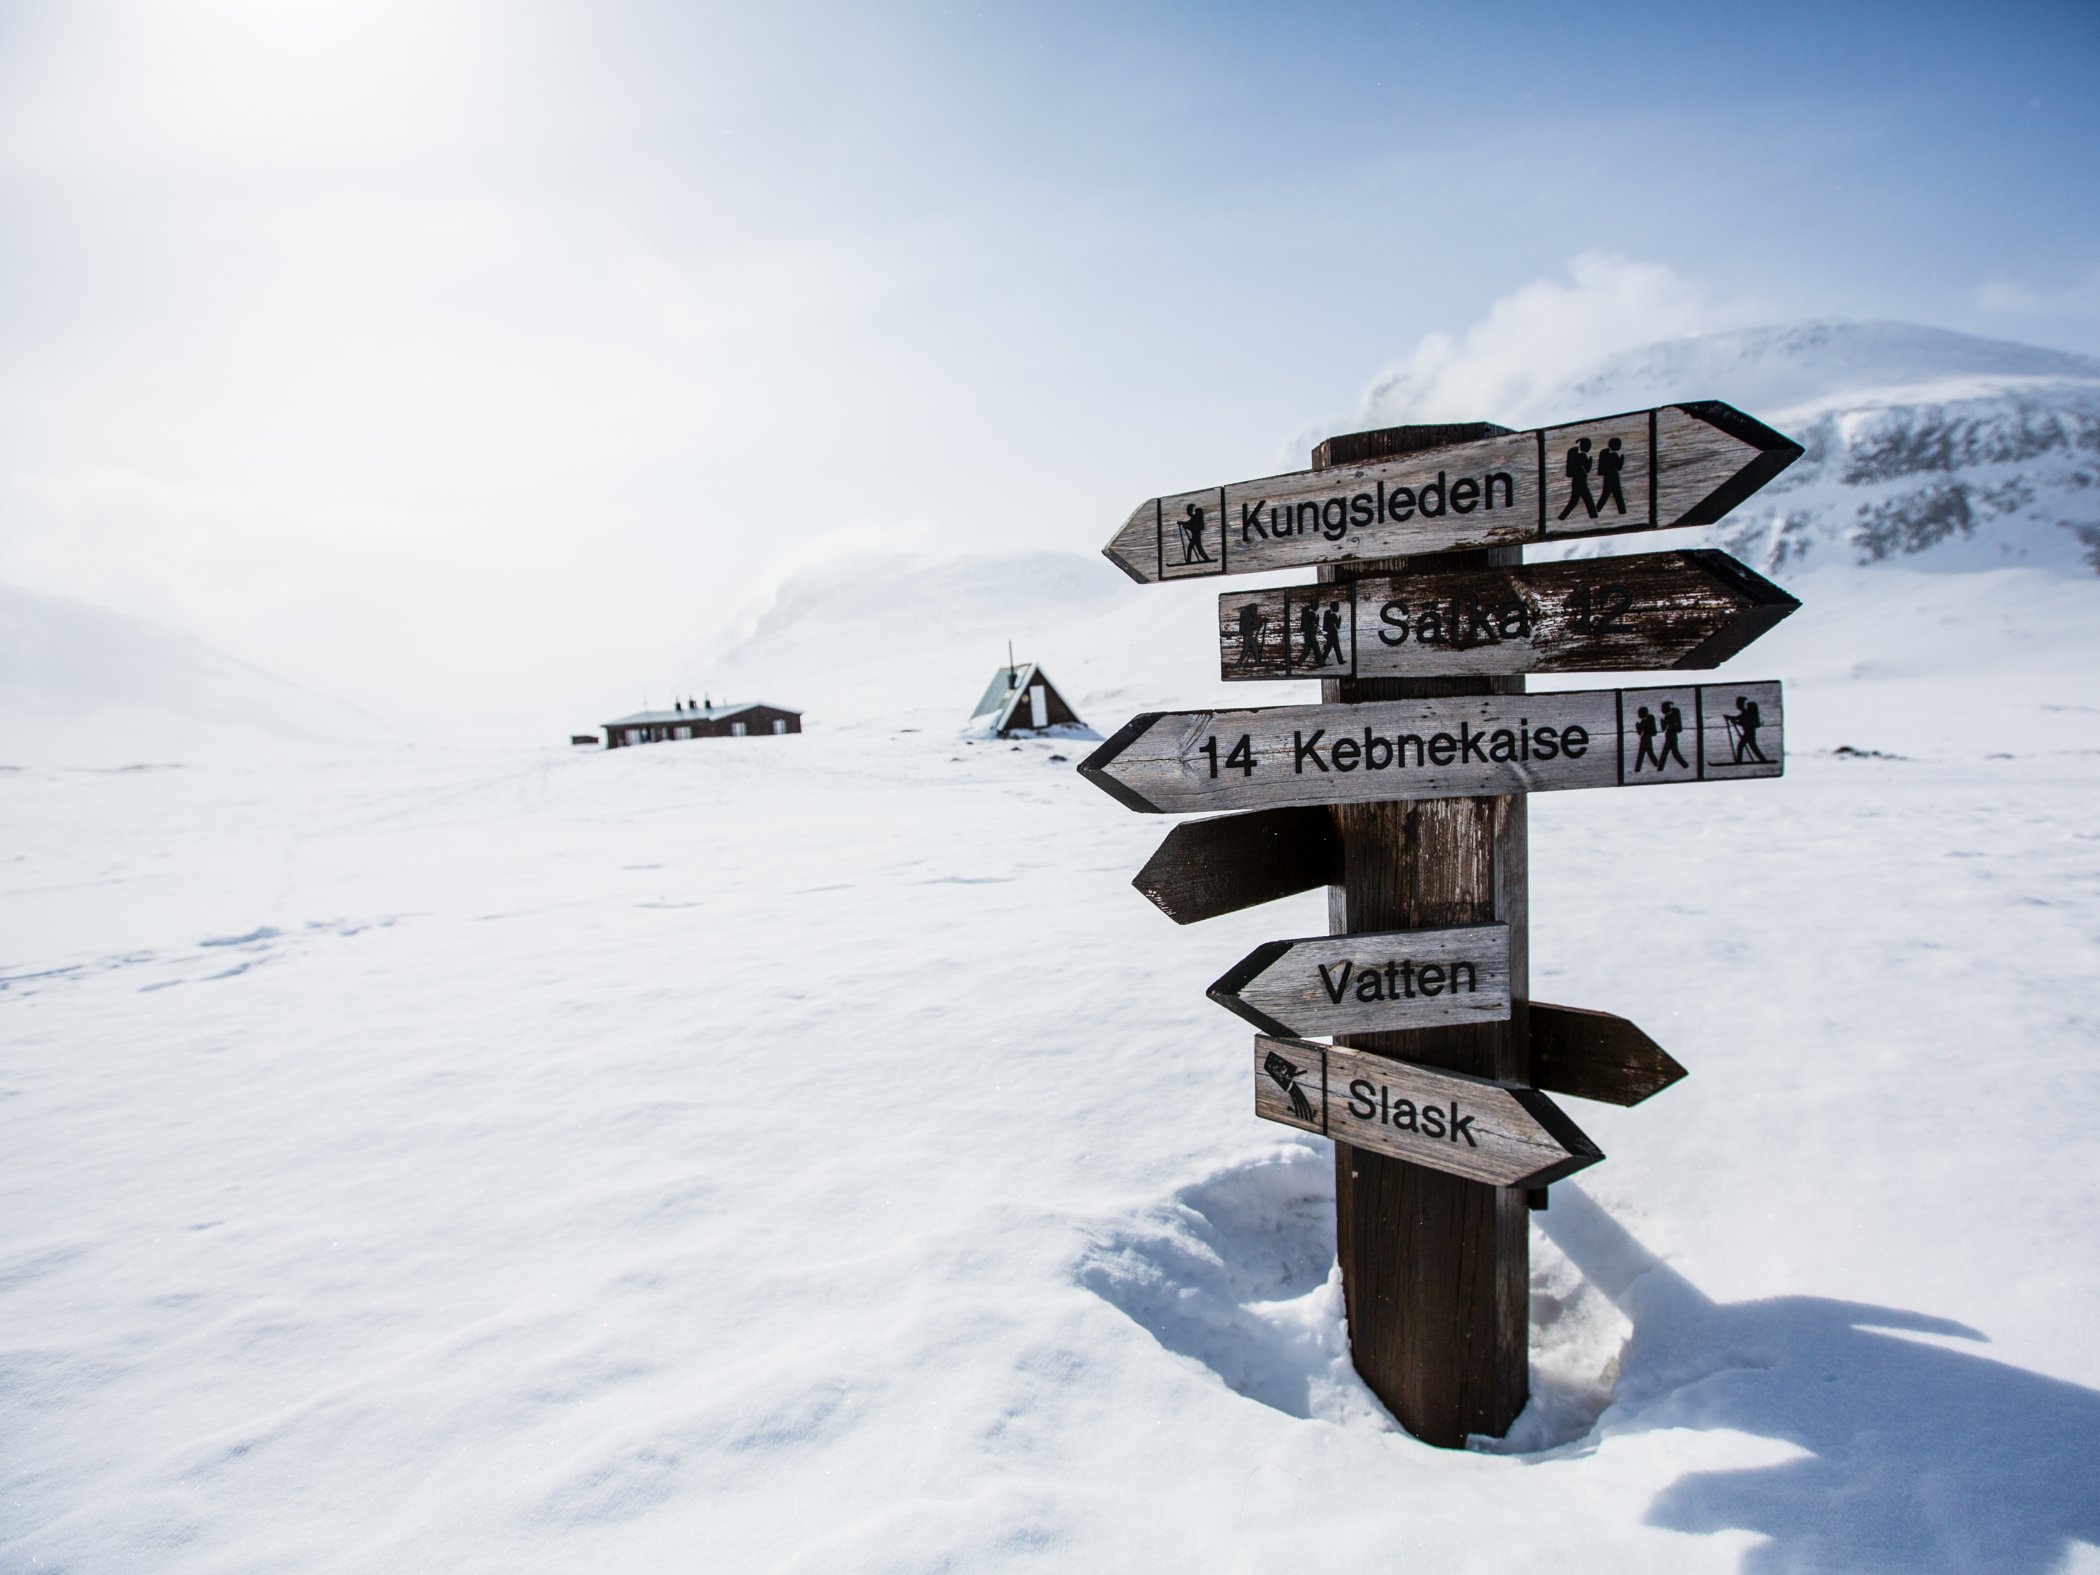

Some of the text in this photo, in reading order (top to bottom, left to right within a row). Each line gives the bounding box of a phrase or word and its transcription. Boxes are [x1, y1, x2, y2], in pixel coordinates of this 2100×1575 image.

[1242, 471, 1514, 541] Kungsleden
[1570, 584, 1635, 636] 12
[1200, 718, 1590, 778] 14 Kebnekaise
[1319, 960, 1476, 1004] Vatten
[1348, 1079, 1478, 1147] Slask
